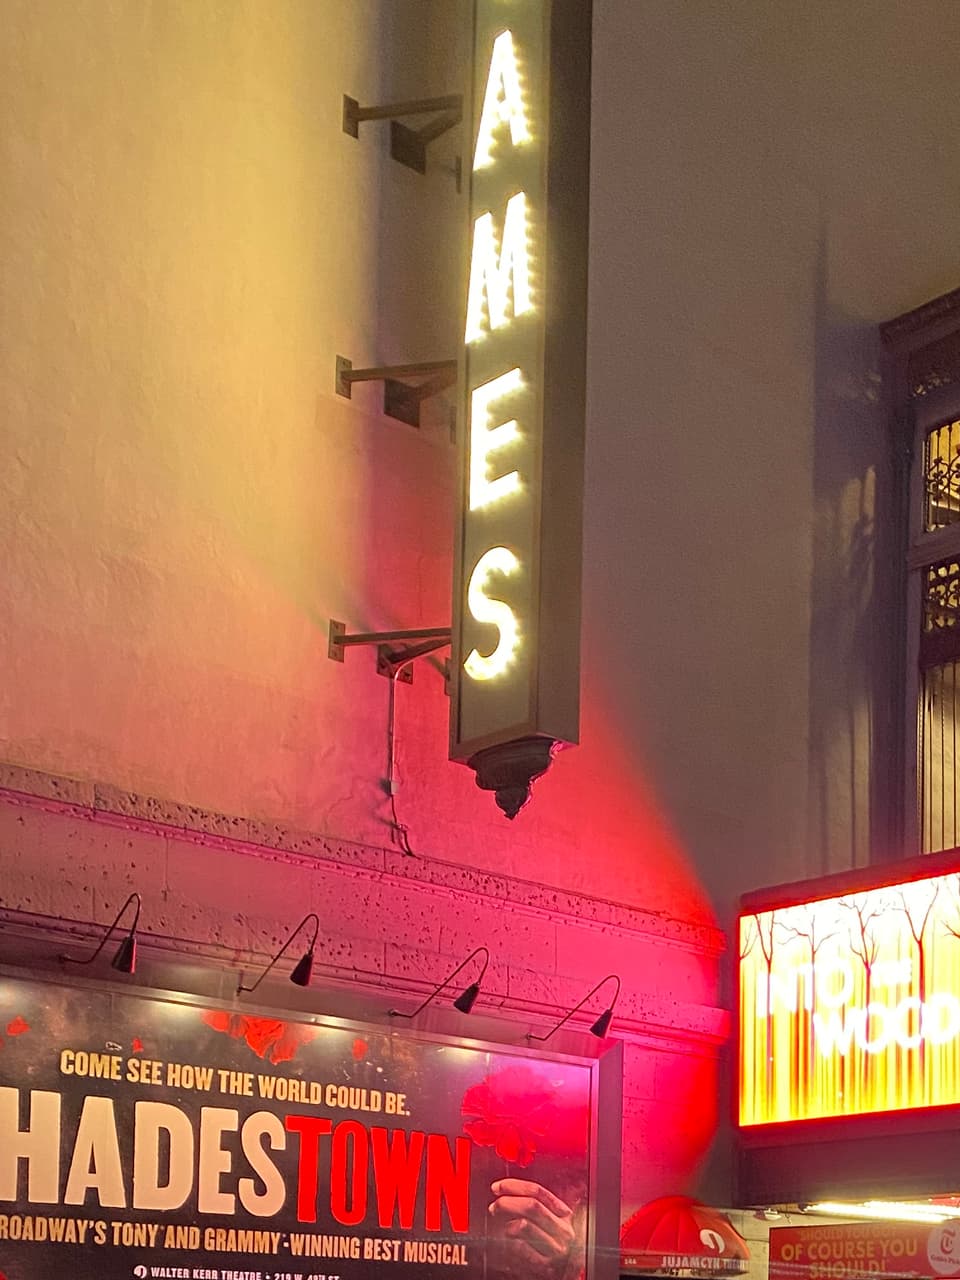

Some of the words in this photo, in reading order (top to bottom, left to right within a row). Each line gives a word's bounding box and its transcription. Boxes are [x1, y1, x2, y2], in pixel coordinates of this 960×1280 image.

[463, 28, 537, 683] AMES
[60, 1050, 123, 1080] COME
[126, 1058, 163, 1086] SEE
[167, 1064, 214, 1092] HOW
[218, 1070, 254, 1097] THE
[258, 1075, 322, 1105] WORLD
[325, 1084, 382, 1112] COULD
[385, 1093, 411, 1116] BE.
[164, 1225, 200, 1250] AND
[363, 1239, 401, 1262] BEST
[403, 1241, 468, 1265] MUSICAL
[781, 1243, 804, 1262] OF
[807, 1241, 875, 1260] COURSE
[879, 1238, 918, 1257] YOU
[151, 1267, 190, 1279] WALTER
[193, 1269, 218, 1280] KERR
